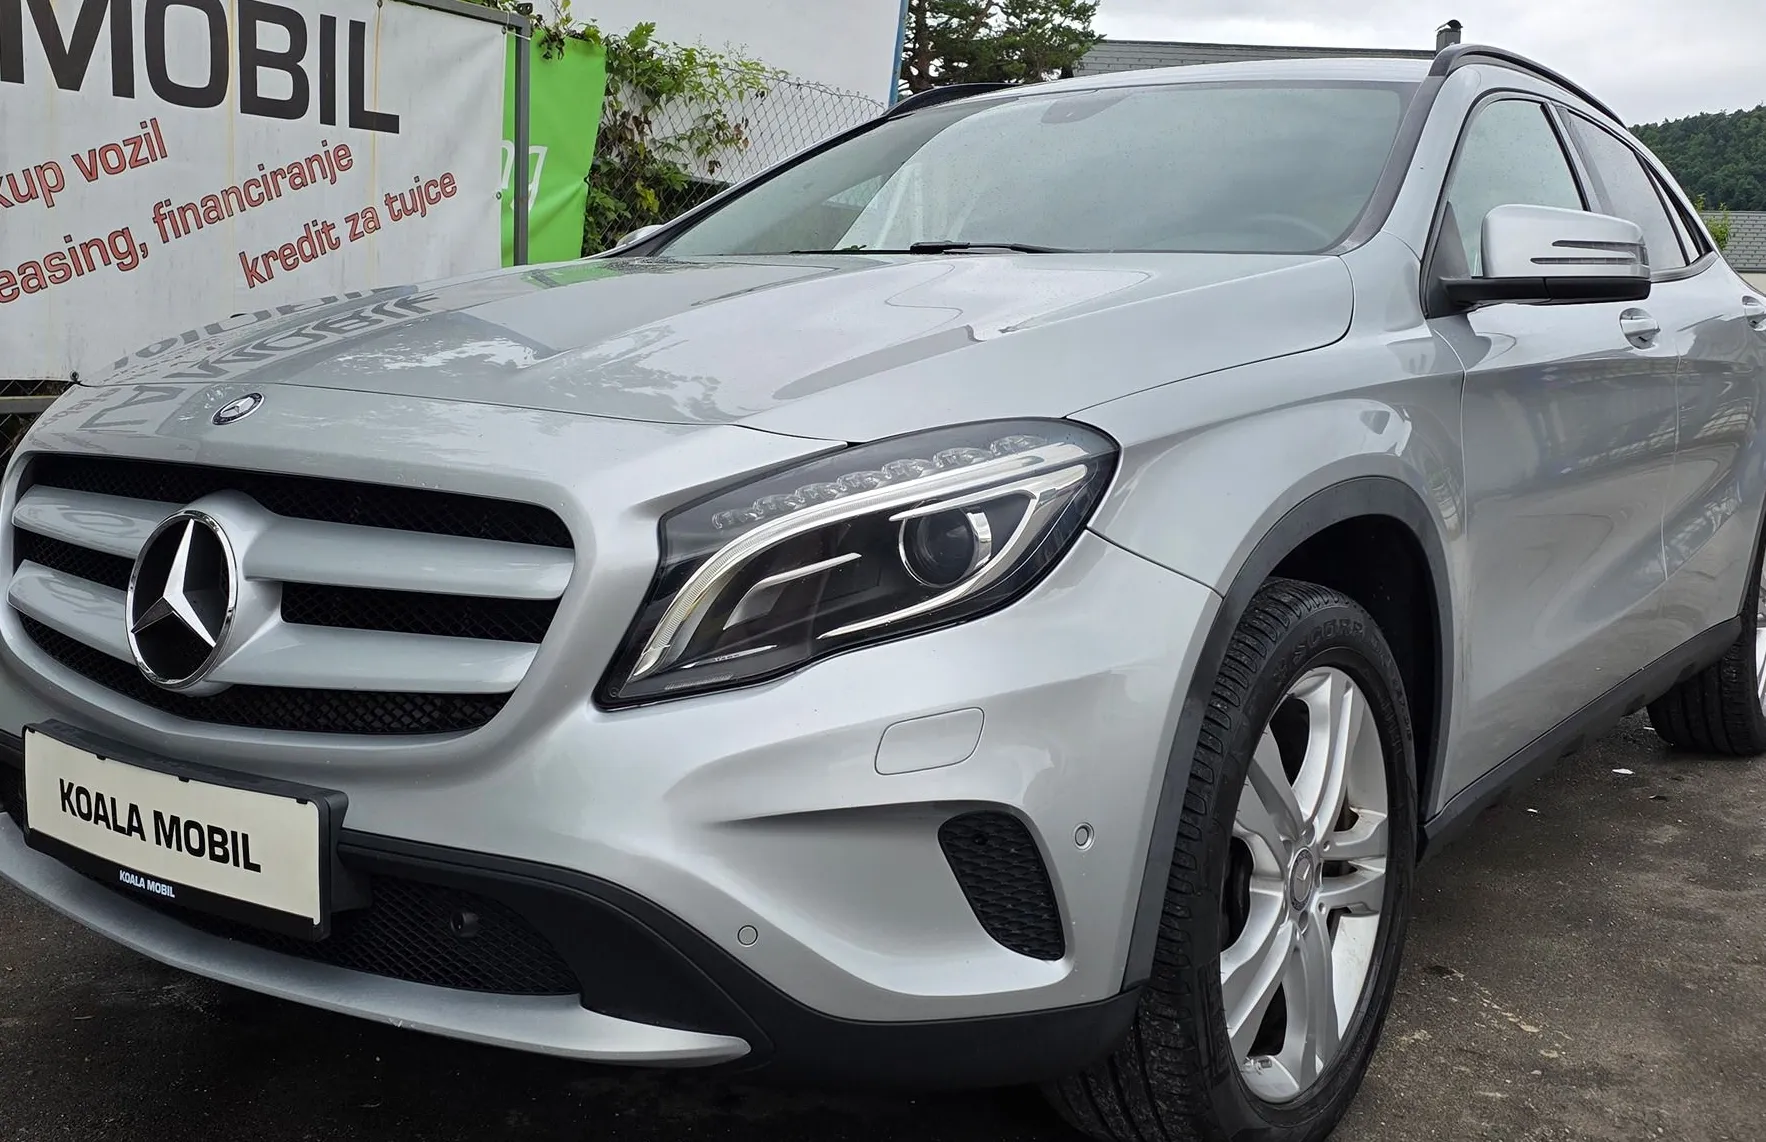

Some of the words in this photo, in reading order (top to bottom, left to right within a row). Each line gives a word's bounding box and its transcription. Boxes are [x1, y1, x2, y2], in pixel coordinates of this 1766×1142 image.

[0, 0, 400, 134] MOBIL
[71, 117, 168, 182] vozil
[152, 139, 353, 244] financiranje
[238, 219, 341, 289] kredit
[344, 206, 381, 243] za
[384, 172, 458, 222] tujce
[59, 777, 147, 842] KOALA
[153, 809, 262, 874] MOBIL
[119, 869, 146, 889] KOALA
[147, 879, 176, 899] MOBIL
